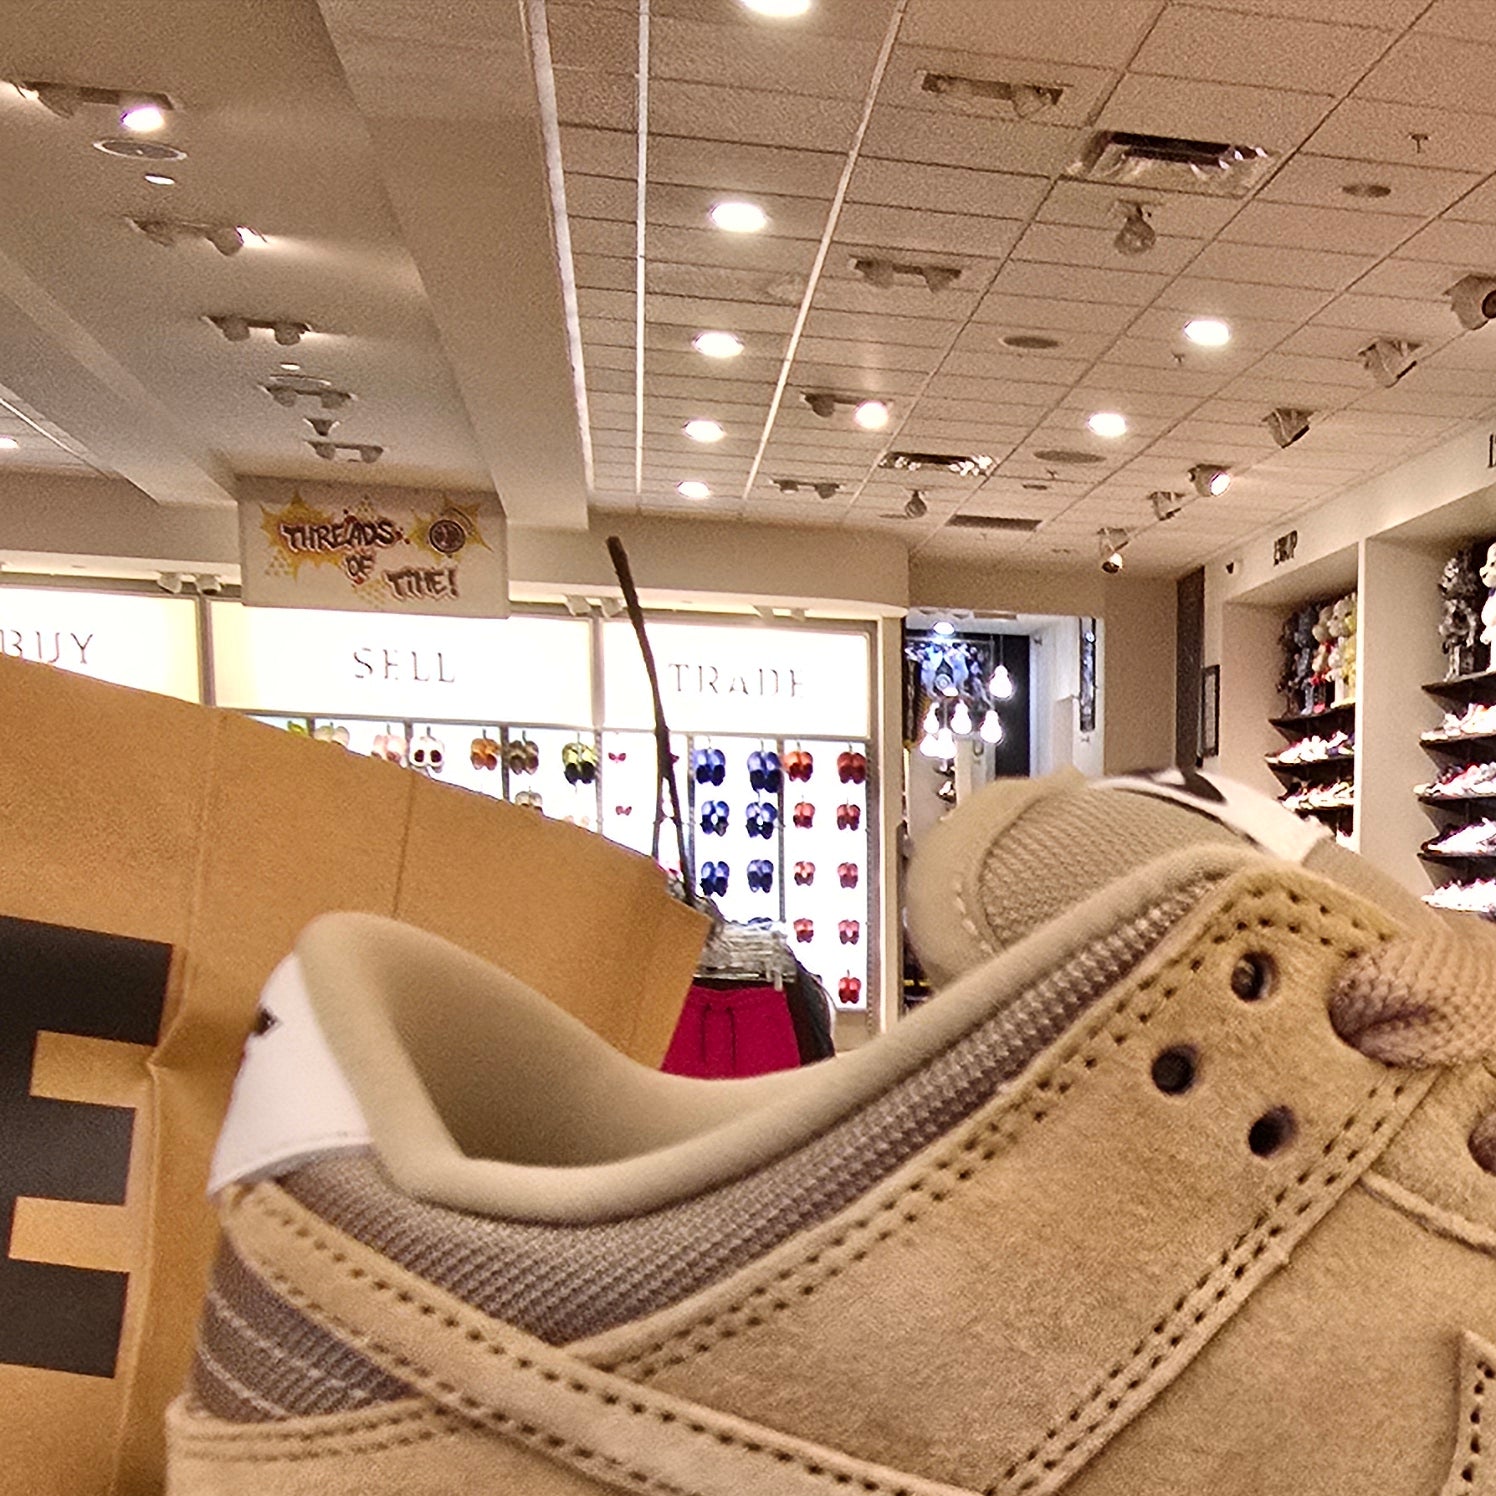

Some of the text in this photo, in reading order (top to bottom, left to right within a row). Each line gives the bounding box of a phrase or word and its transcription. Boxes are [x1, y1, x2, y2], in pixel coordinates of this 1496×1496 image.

[281, 519, 397, 551] THREADS
[345, 552, 376, 578] OF
[0, 629, 93, 664] BUY
[353, 647, 456, 683] SELL
[668, 663, 804, 698] TRADE
